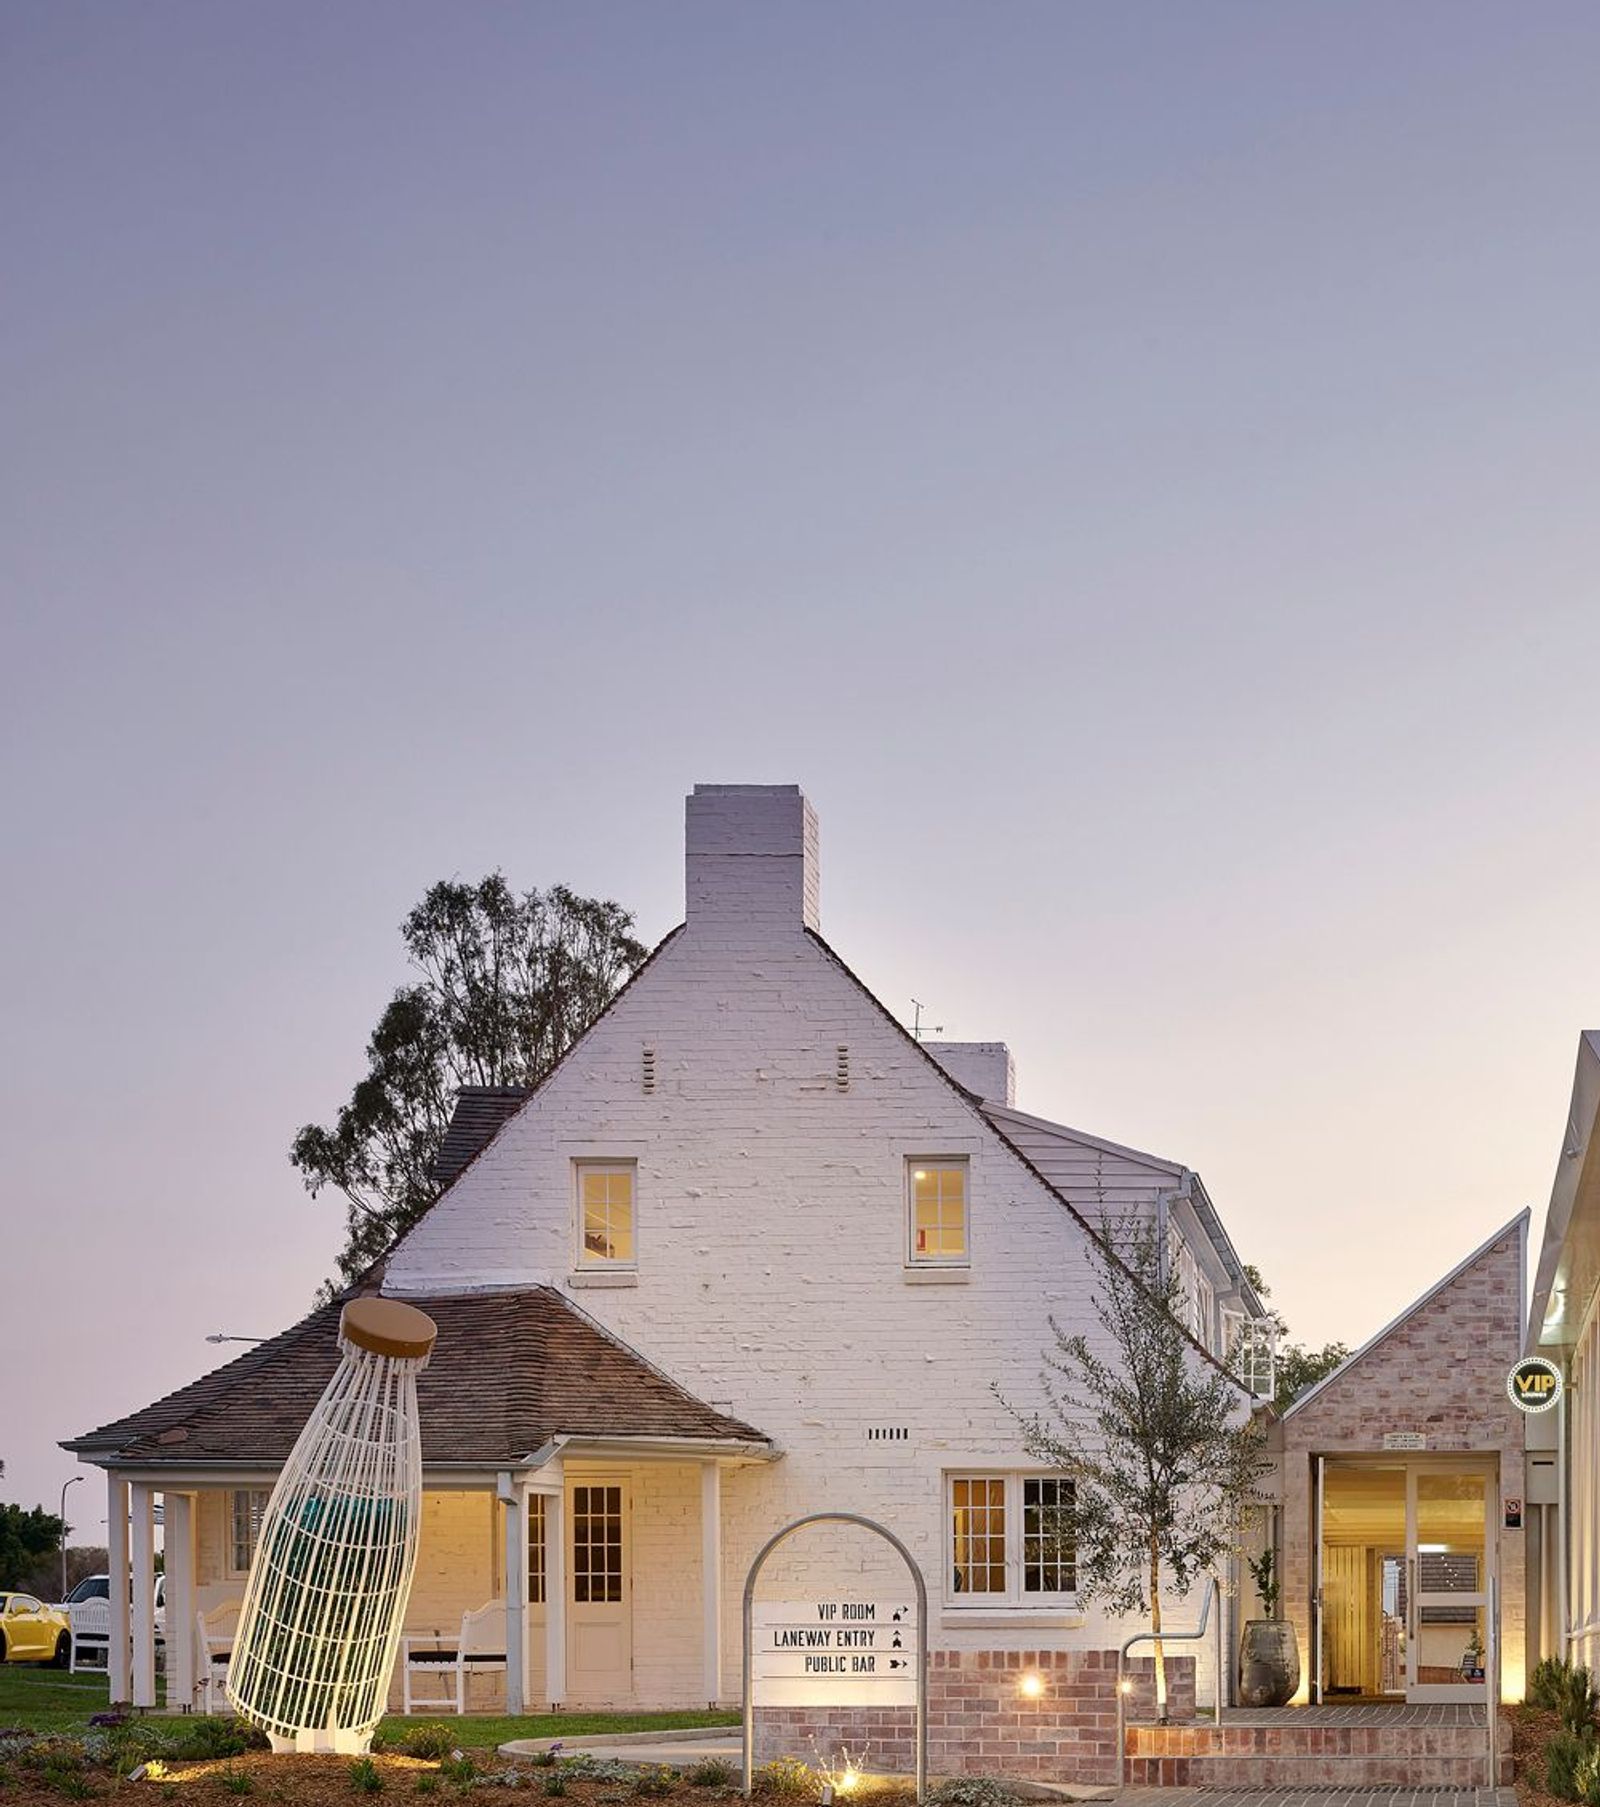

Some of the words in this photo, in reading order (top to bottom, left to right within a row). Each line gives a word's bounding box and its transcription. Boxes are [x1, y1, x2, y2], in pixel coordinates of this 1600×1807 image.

[1515, 1374, 1555, 1392] VIP
[817, 1603, 837, 1620] VIP
[842, 1603, 875, 1620] ROOM
[774, 1630, 831, 1647] LANEWAY
[836, 1630, 875, 1647] ENTRY
[805, 1656, 846, 1673] PUBLIC
[852, 1656, 875, 1673] BAR
